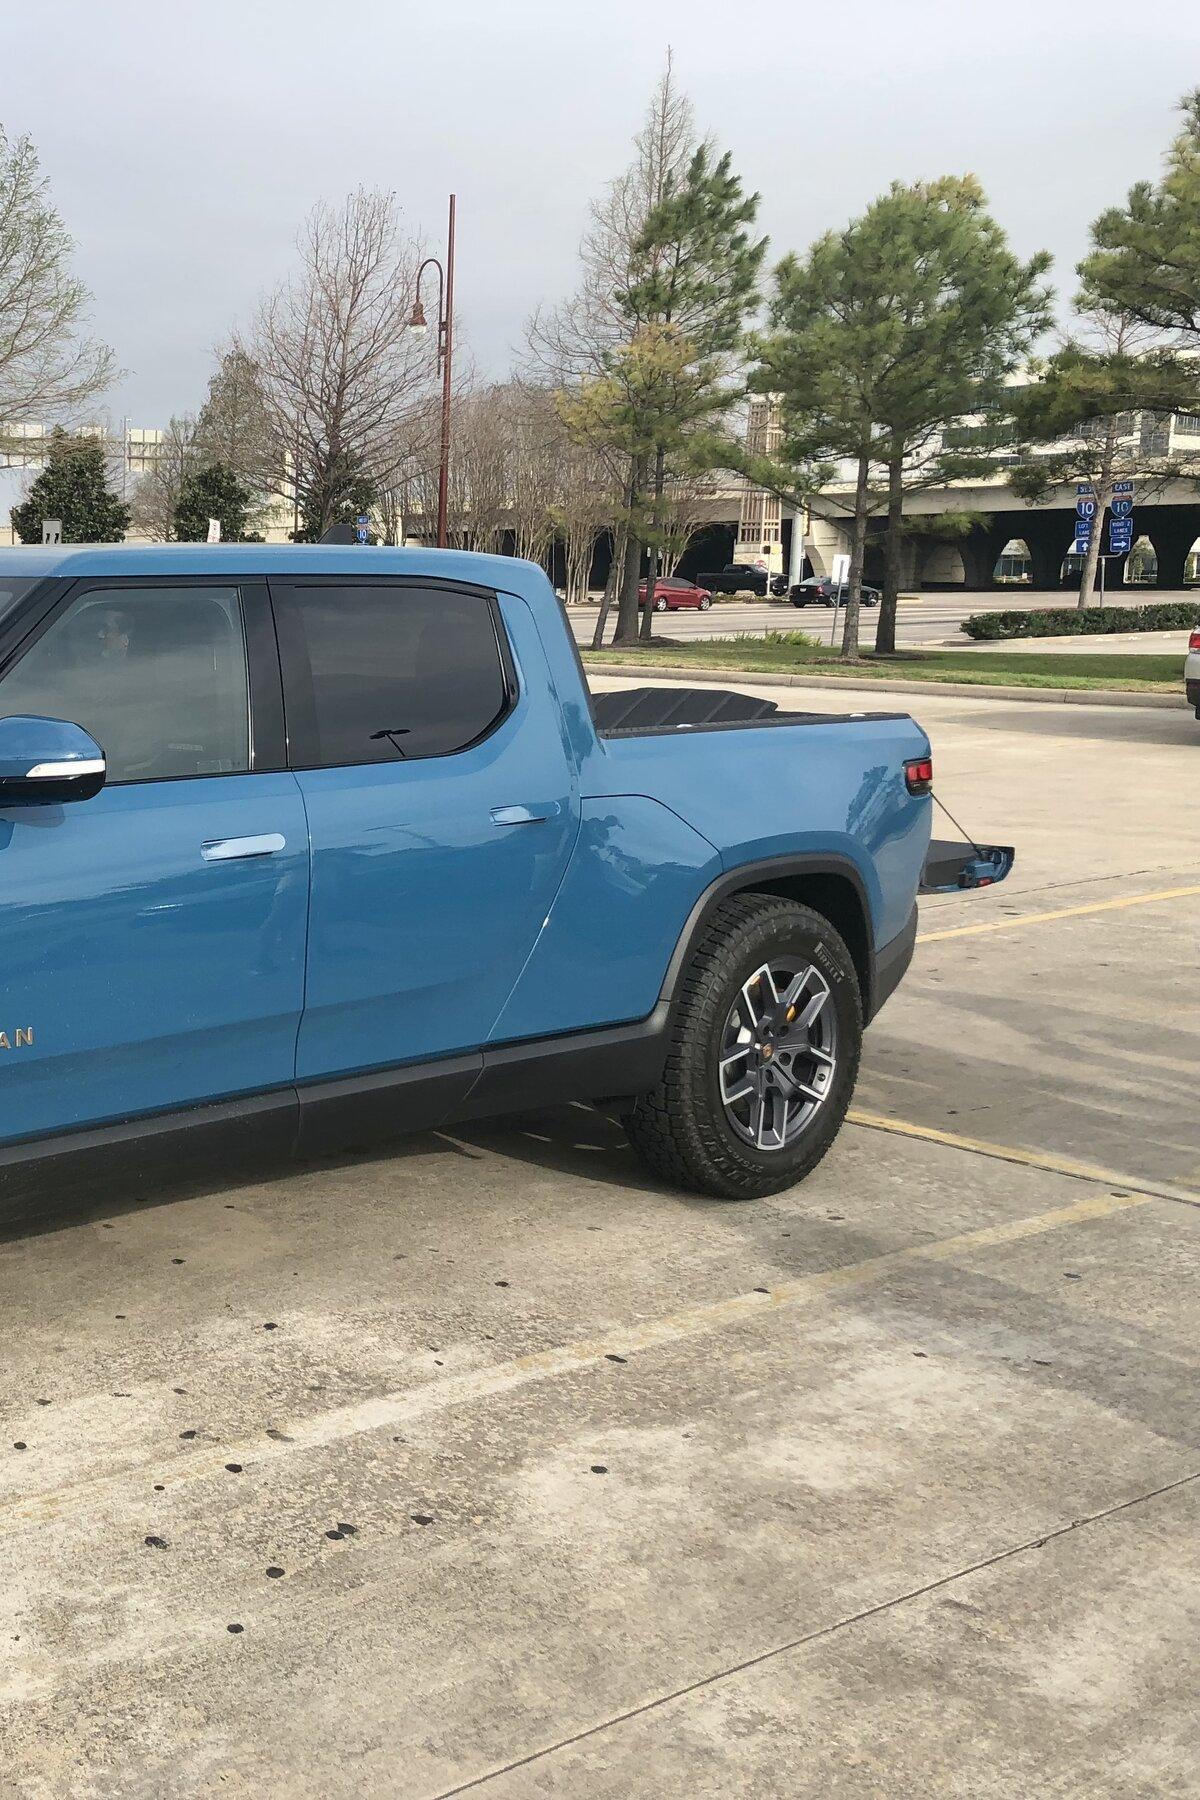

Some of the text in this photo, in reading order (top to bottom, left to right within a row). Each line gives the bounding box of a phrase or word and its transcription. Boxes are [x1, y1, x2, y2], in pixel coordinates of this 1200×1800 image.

[1114, 483, 1131, 491] EAST
[1081, 502, 1094, 515] 10
[1116, 501, 1129, 513] 10
